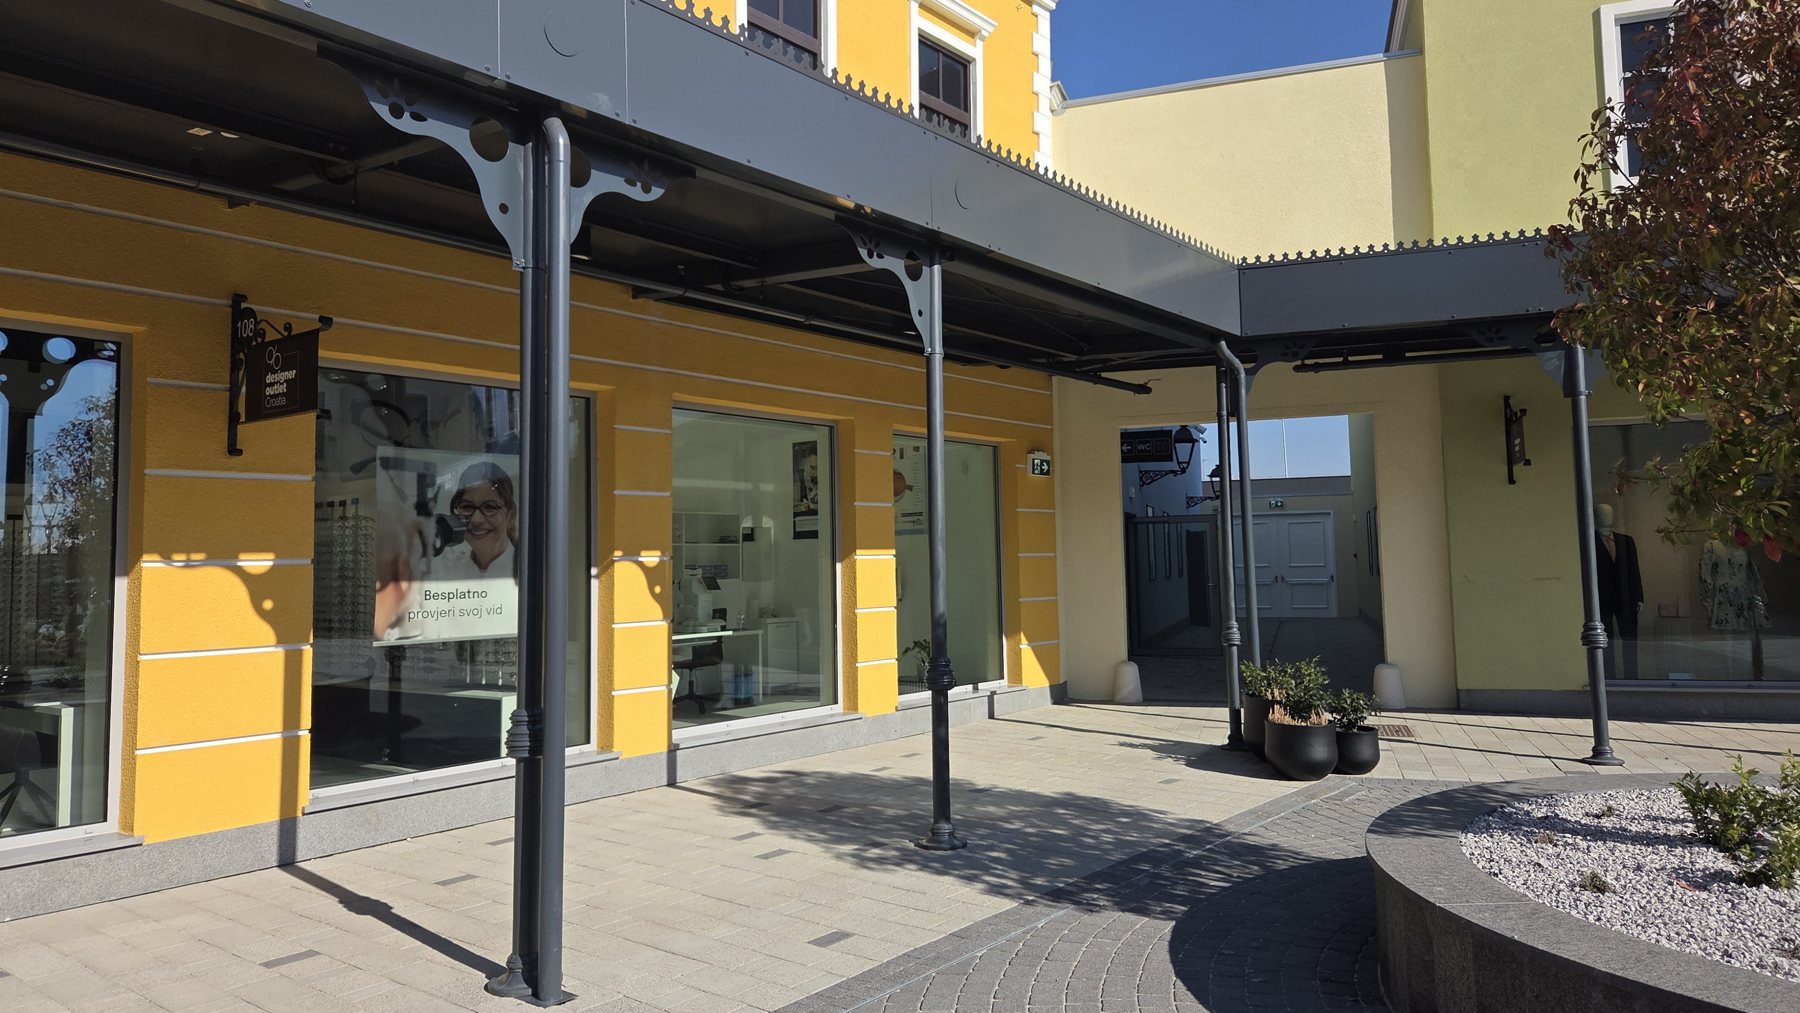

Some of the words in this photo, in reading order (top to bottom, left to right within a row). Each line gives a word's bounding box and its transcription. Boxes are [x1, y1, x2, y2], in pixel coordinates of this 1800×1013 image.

[237, 319, 254, 338] 108
[265, 369, 296, 383] designer
[265, 383, 287, 395] outlet
[265, 396, 286, 407] Croatia
[424, 588, 488, 603] Besplatno
[407, 606, 455, 622] provjeri
[458, 604, 483, 619] svoj
[486, 603, 503, 616] vid
